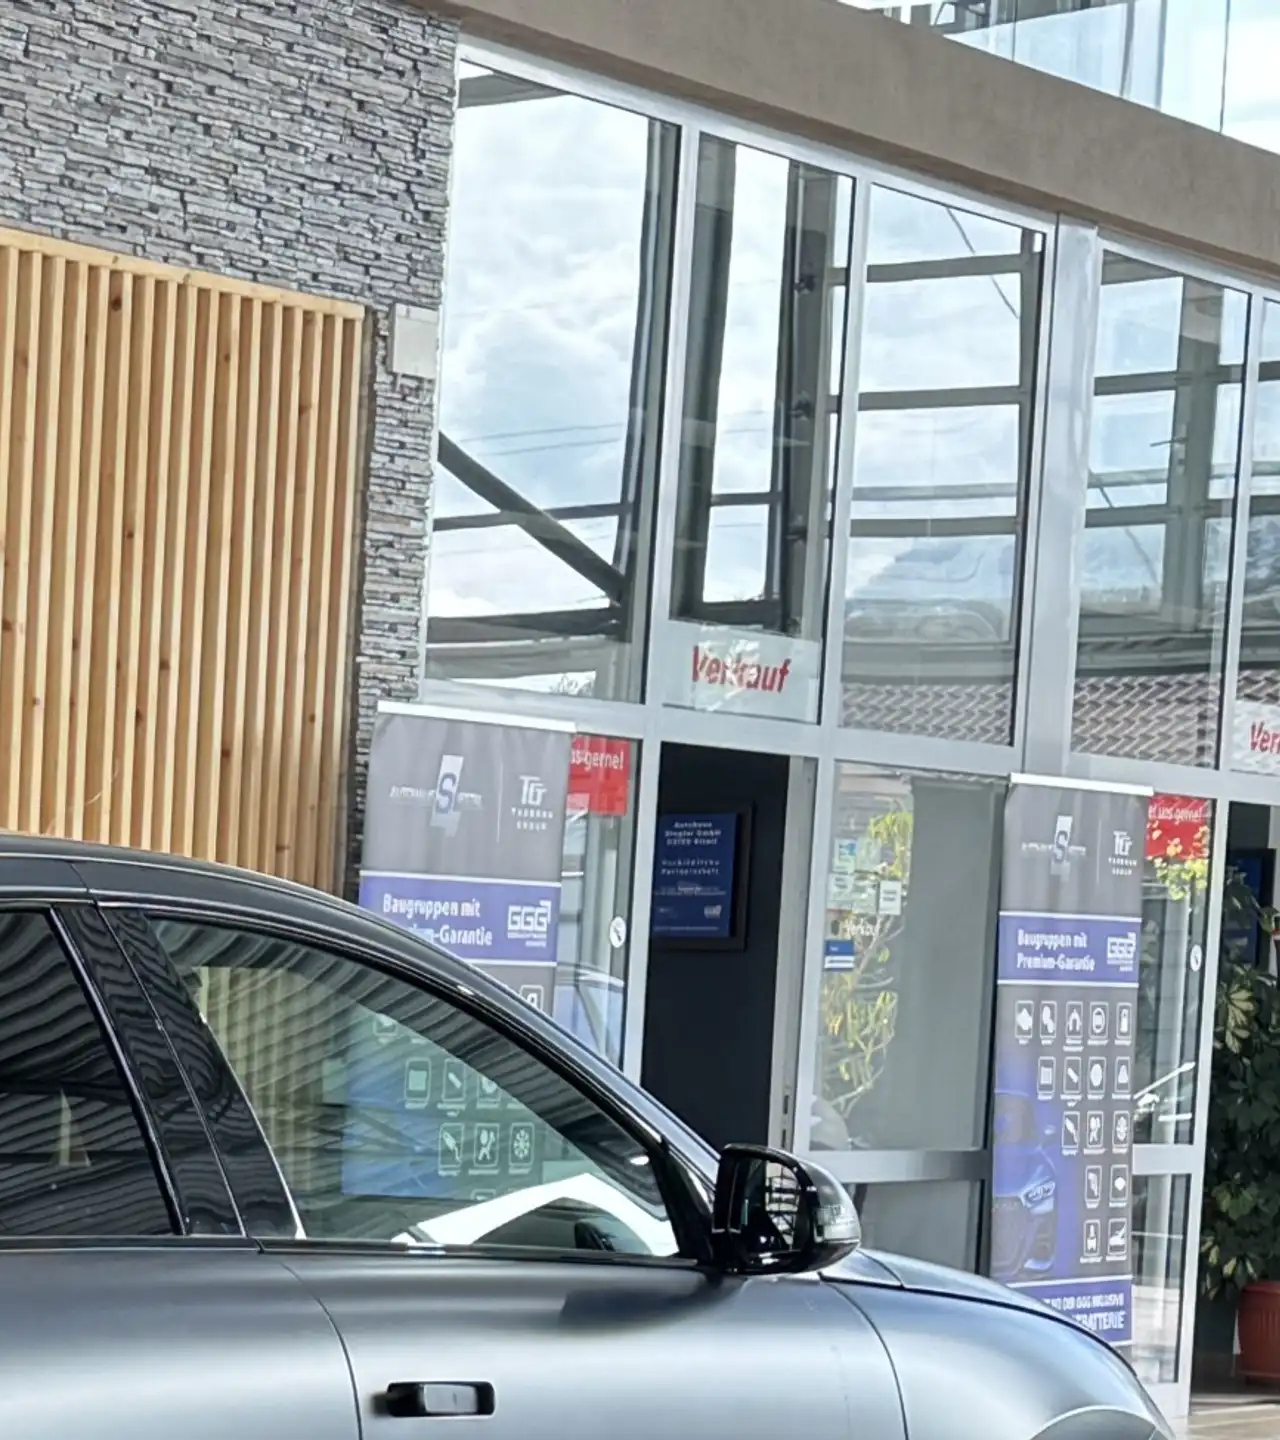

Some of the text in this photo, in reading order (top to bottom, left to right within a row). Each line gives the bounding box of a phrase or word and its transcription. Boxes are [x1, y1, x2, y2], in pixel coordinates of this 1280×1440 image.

[1251, 720, 1280, 755] Ver
[383, 894, 481, 920] Baugruppen mit
